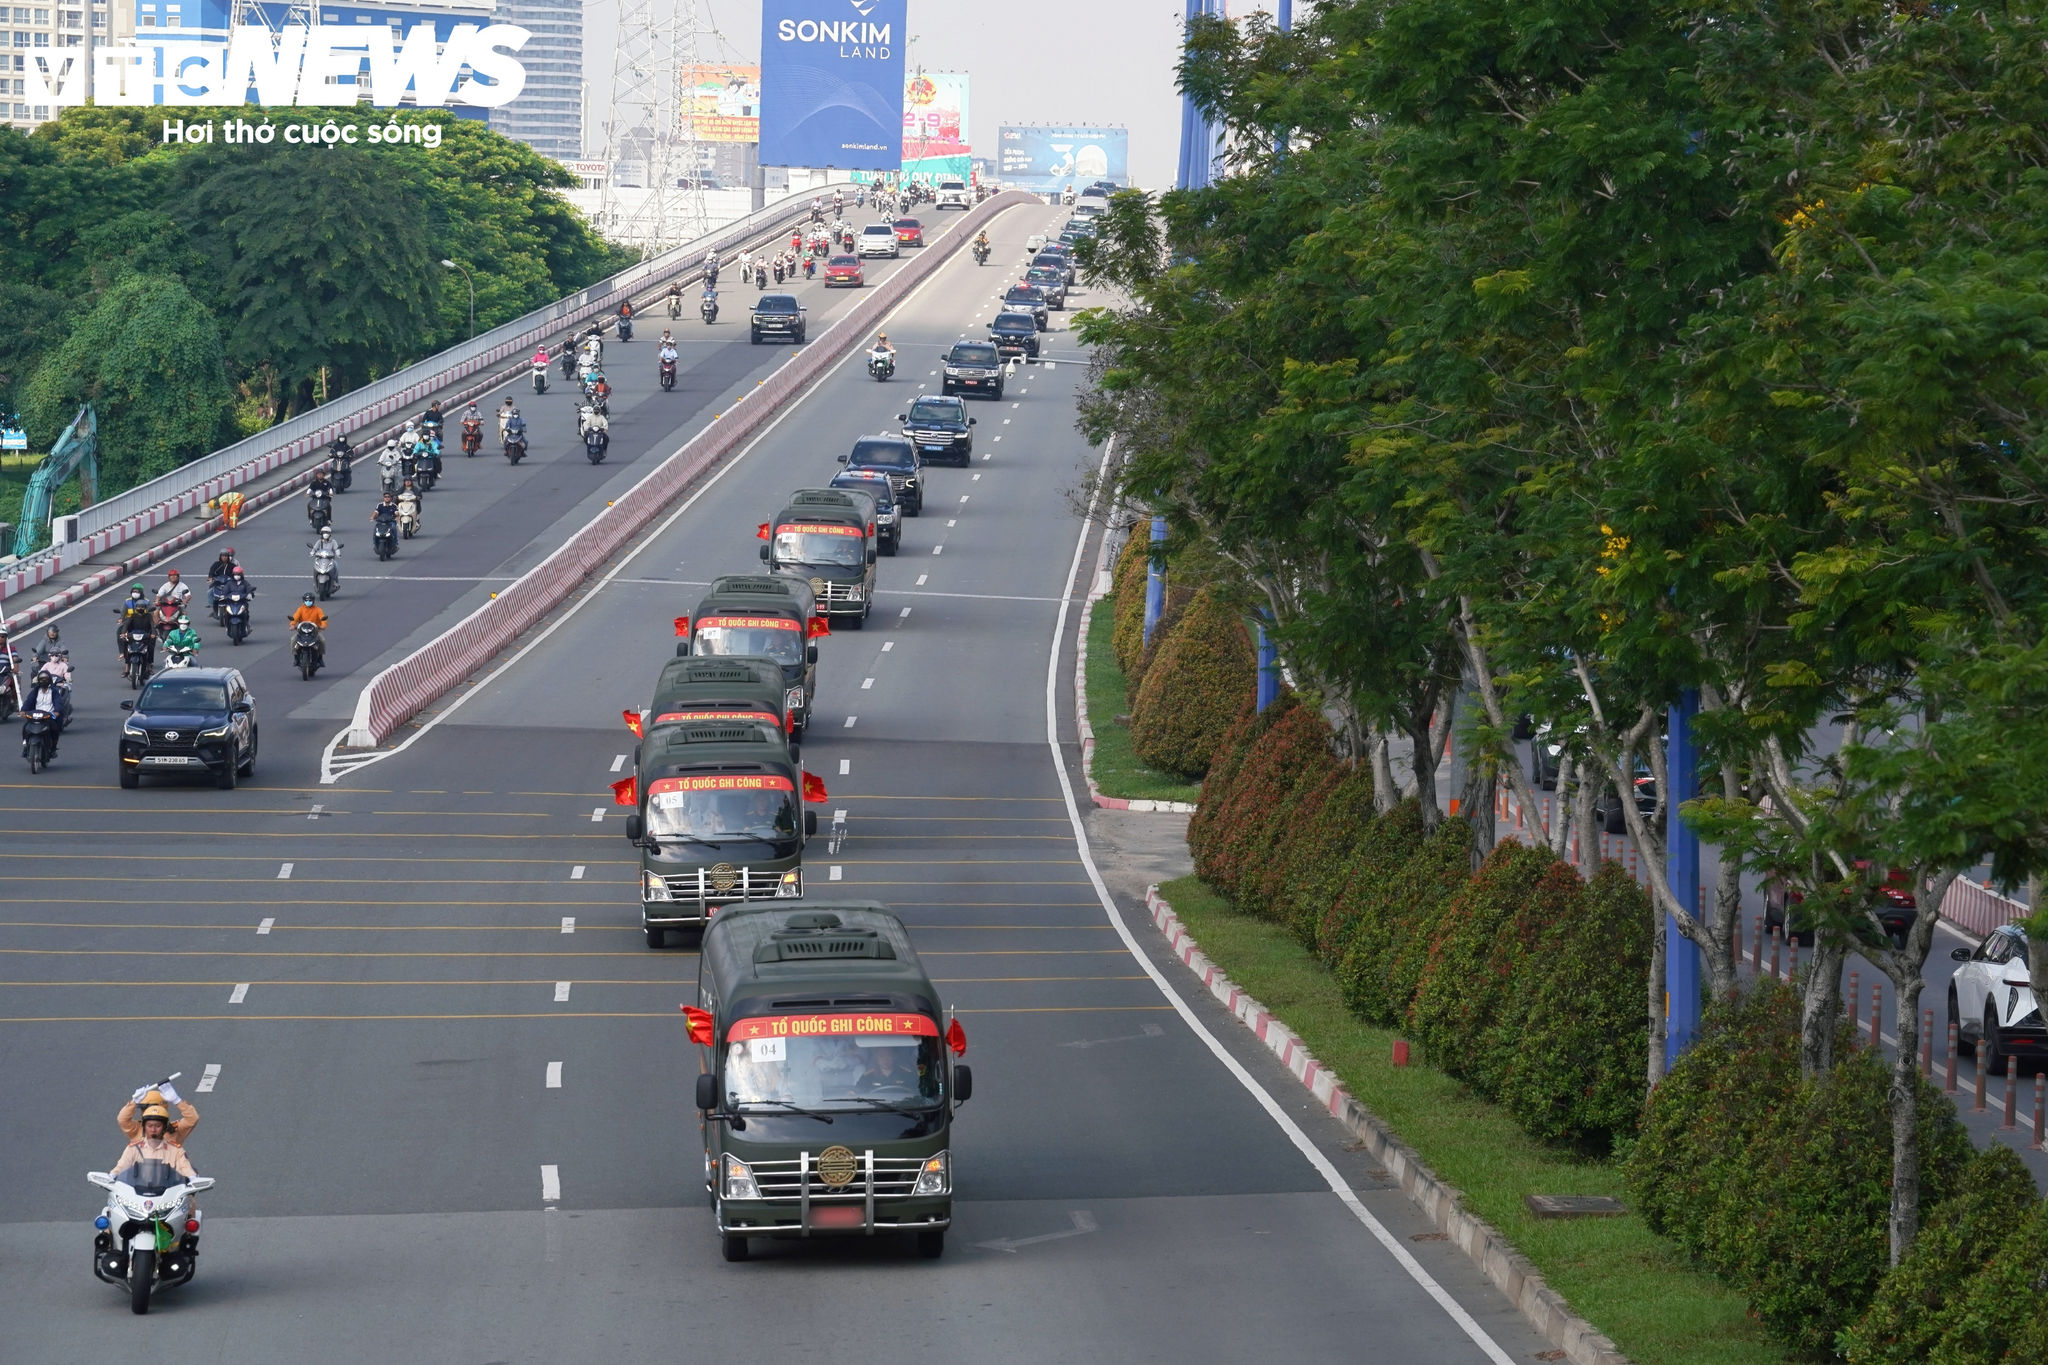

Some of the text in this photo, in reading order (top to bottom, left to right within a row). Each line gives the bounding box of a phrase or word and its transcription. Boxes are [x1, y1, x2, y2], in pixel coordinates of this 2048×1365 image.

[778, 19, 891, 45] SONKIM
[840, 46, 891, 60] LAND
[841, 143, 888, 151] sonkimland.vn
[575, 163, 606, 171] TOYOTA
[728, 618, 746, 627] QUỐC
[760, 619, 780, 628] CÔNG
[678, 776, 762, 790] TỔ QUỐC GHI CÔNG
[665, 795, 678, 805] 05
[771, 1015, 893, 1035] TỔ QUỐC GHI CÔNG
[760, 1044, 777, 1057] 04
